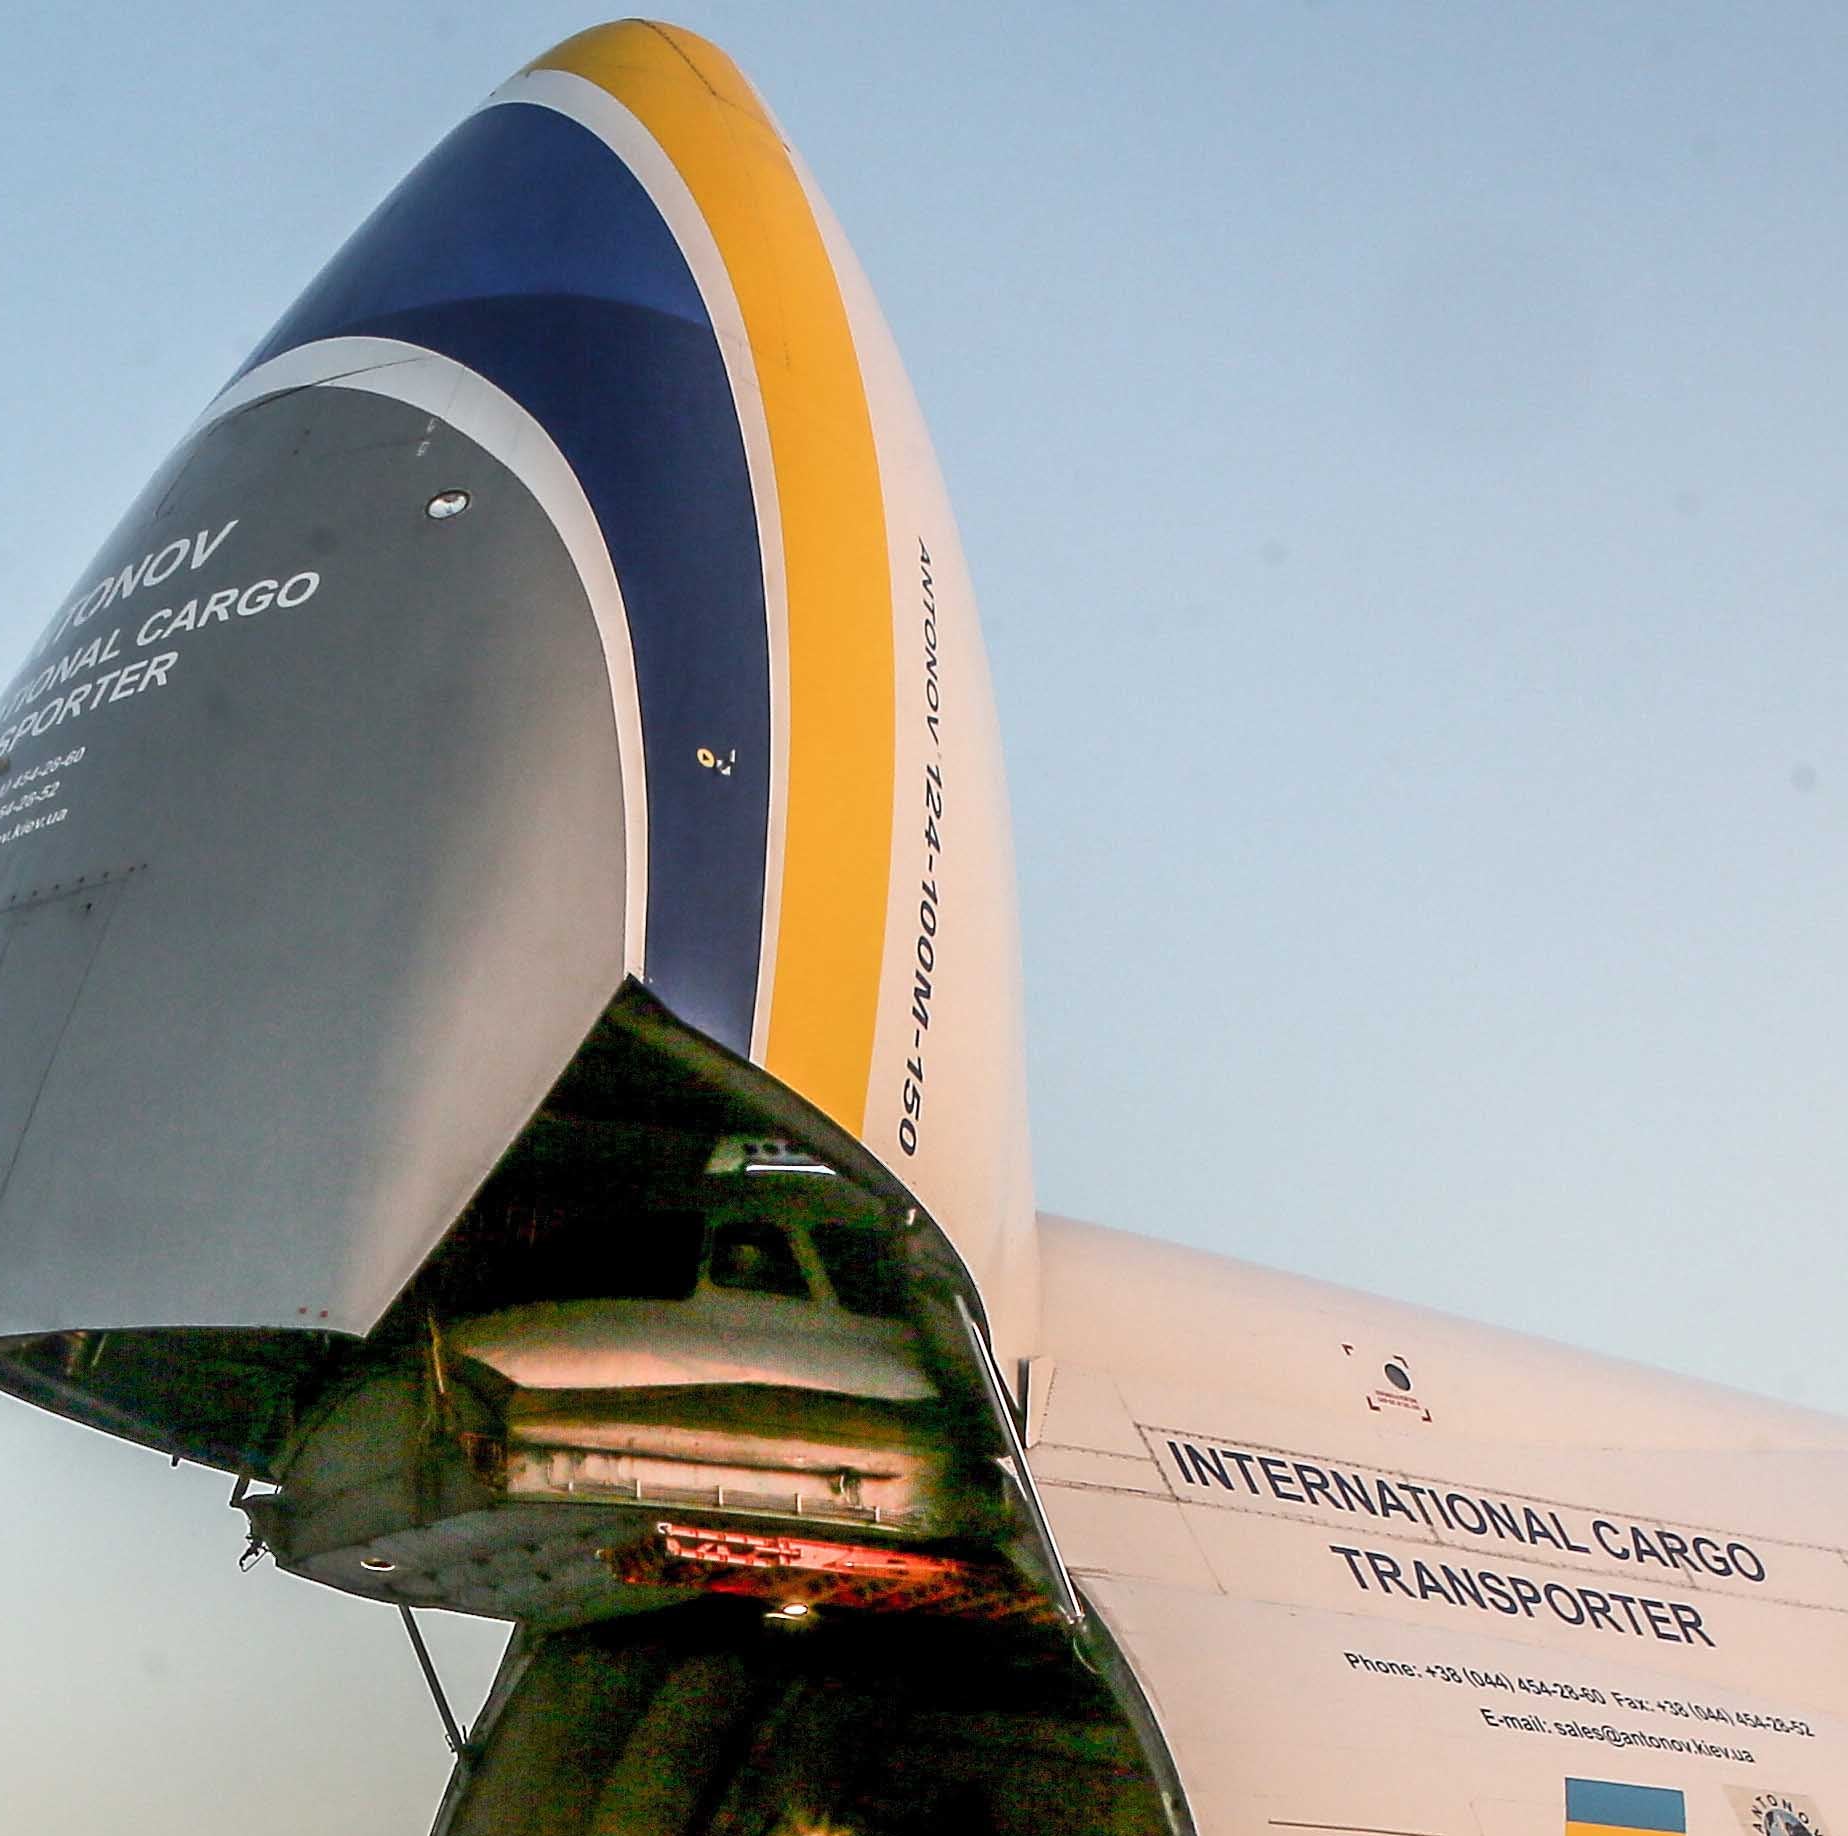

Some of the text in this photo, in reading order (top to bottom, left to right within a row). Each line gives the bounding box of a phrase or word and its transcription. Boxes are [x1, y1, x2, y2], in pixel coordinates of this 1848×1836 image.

[136, 571, 320, 647] CARGO
[899, 535, 942, 1157] ANTONOV 124-100M-150
[1166, 1440, 1766, 1583] INTERNATIONAL CARGO
[1331, 1545, 1716, 1648] TRANSPORTER
[1343, 1652, 1816, 1738] Phone: +38 (044) 454-28-60 Fax: +38 (044) 454-28-52
[1480, 1708, 1756, 1764] E-mail: sales@antonov.kiev.ua
